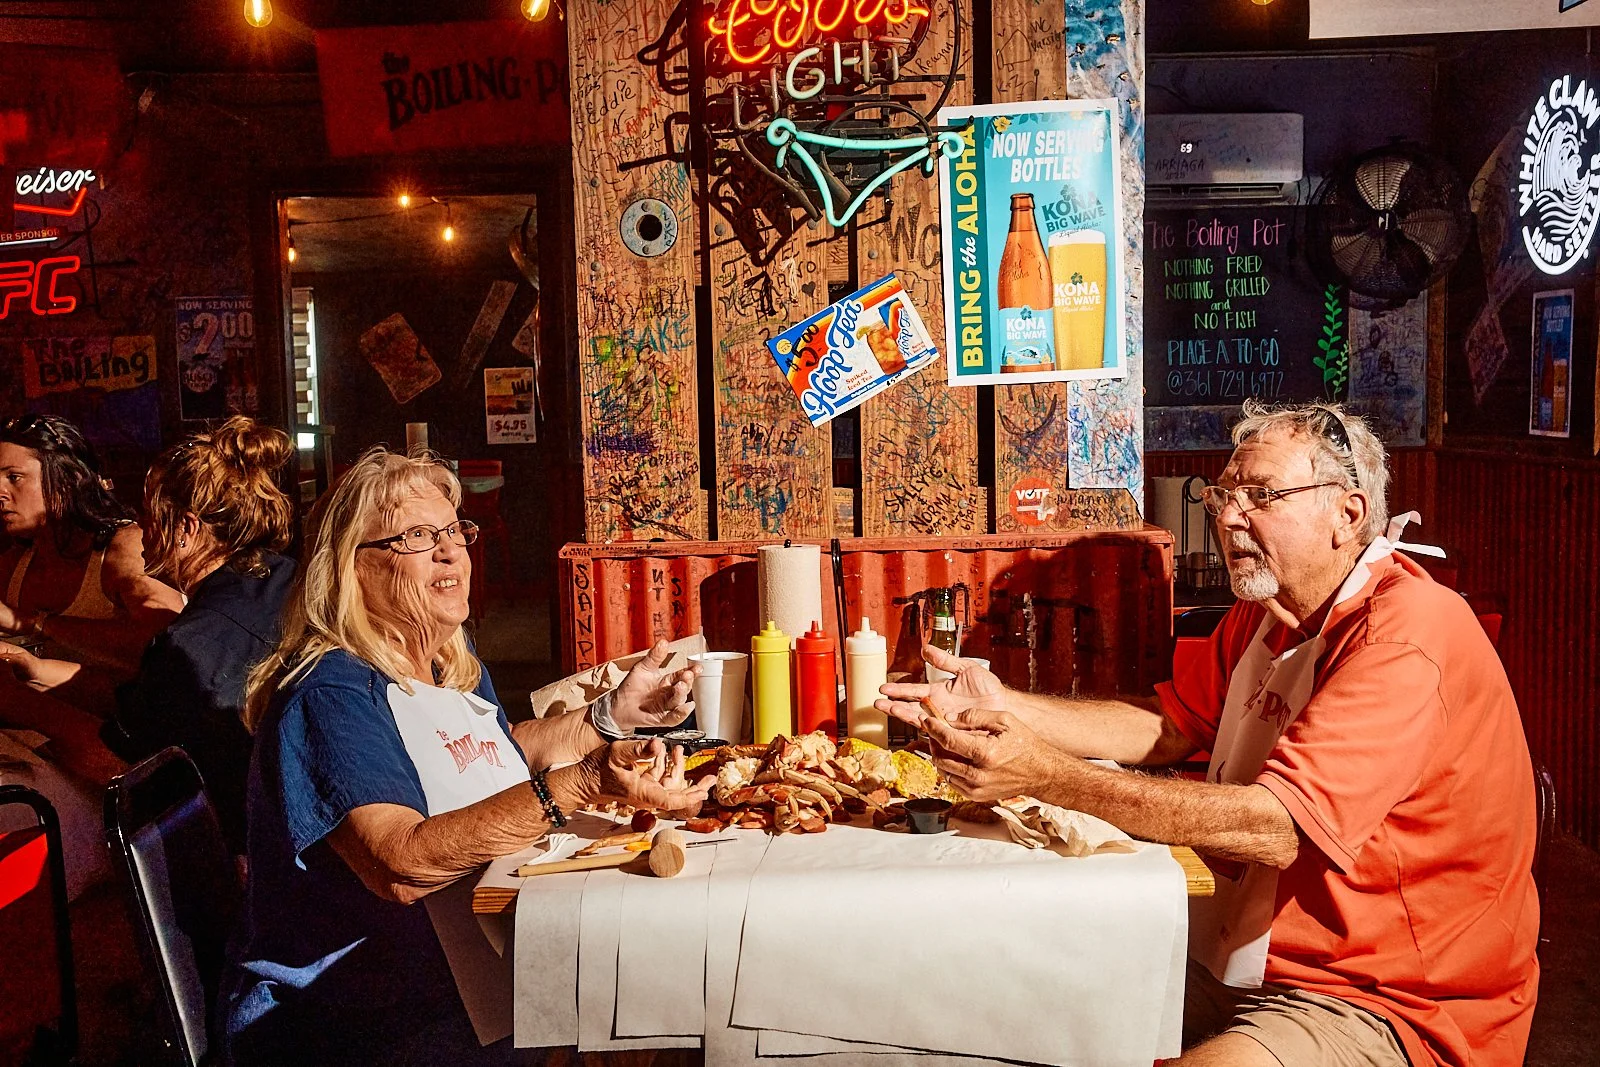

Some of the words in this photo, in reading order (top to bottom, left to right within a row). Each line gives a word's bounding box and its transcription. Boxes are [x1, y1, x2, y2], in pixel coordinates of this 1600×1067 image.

[991, 131, 1032, 159] NOW
[1179, 142, 1194, 154] 69
[16, 166, 97, 197] eiser
[1010, 156, 1082, 184] BOTTLES
[1045, 217, 1069, 234] BIG
[1070, 206, 1107, 227] WAVE
[14, 226, 61, 242] SPONSOR
[1186, 217, 1240, 255] Boiling
[1252, 216, 1287, 248] Pot
[959, 236, 977, 268] the
[1164, 256, 1215, 278] NOTHING
[1226, 254, 1264, 275] FRIED
[1053, 281, 1101, 297] KONA
[1053, 296, 1073, 307] BIG
[1072, 295, 1102, 306] WAVE
[1164, 278, 1215, 301] NOTHING
[1225, 276, 1272, 299] GRILLED
[206, 299, 254, 311] SERVING
[1210, 298, 1232, 311] and
[827, 302, 863, 350] Tea
[959, 269, 984, 368] BRING
[1006, 316, 1047, 333] KONA
[1194, 311, 1219, 330] NO
[1225, 310, 1258, 330] FISH
[1006, 331, 1022, 341] BIG
[1022, 329, 1048, 340] WAVE
[1167, 338, 1214, 367] PLACE
[1216, 338, 1231, 366] A
[1231, 336, 1281, 367] TO-GO
[803, 348, 854, 417] Hoop
[845, 368, 869, 385] Spiked
[847, 378, 862, 392] Iced
[860, 373, 874, 387] Tea
[1216, 369, 1246, 398] 729
[908, 491, 955, 534] NORMA
[924, 514, 949, 535] were
[945, 509, 967, 530] here
